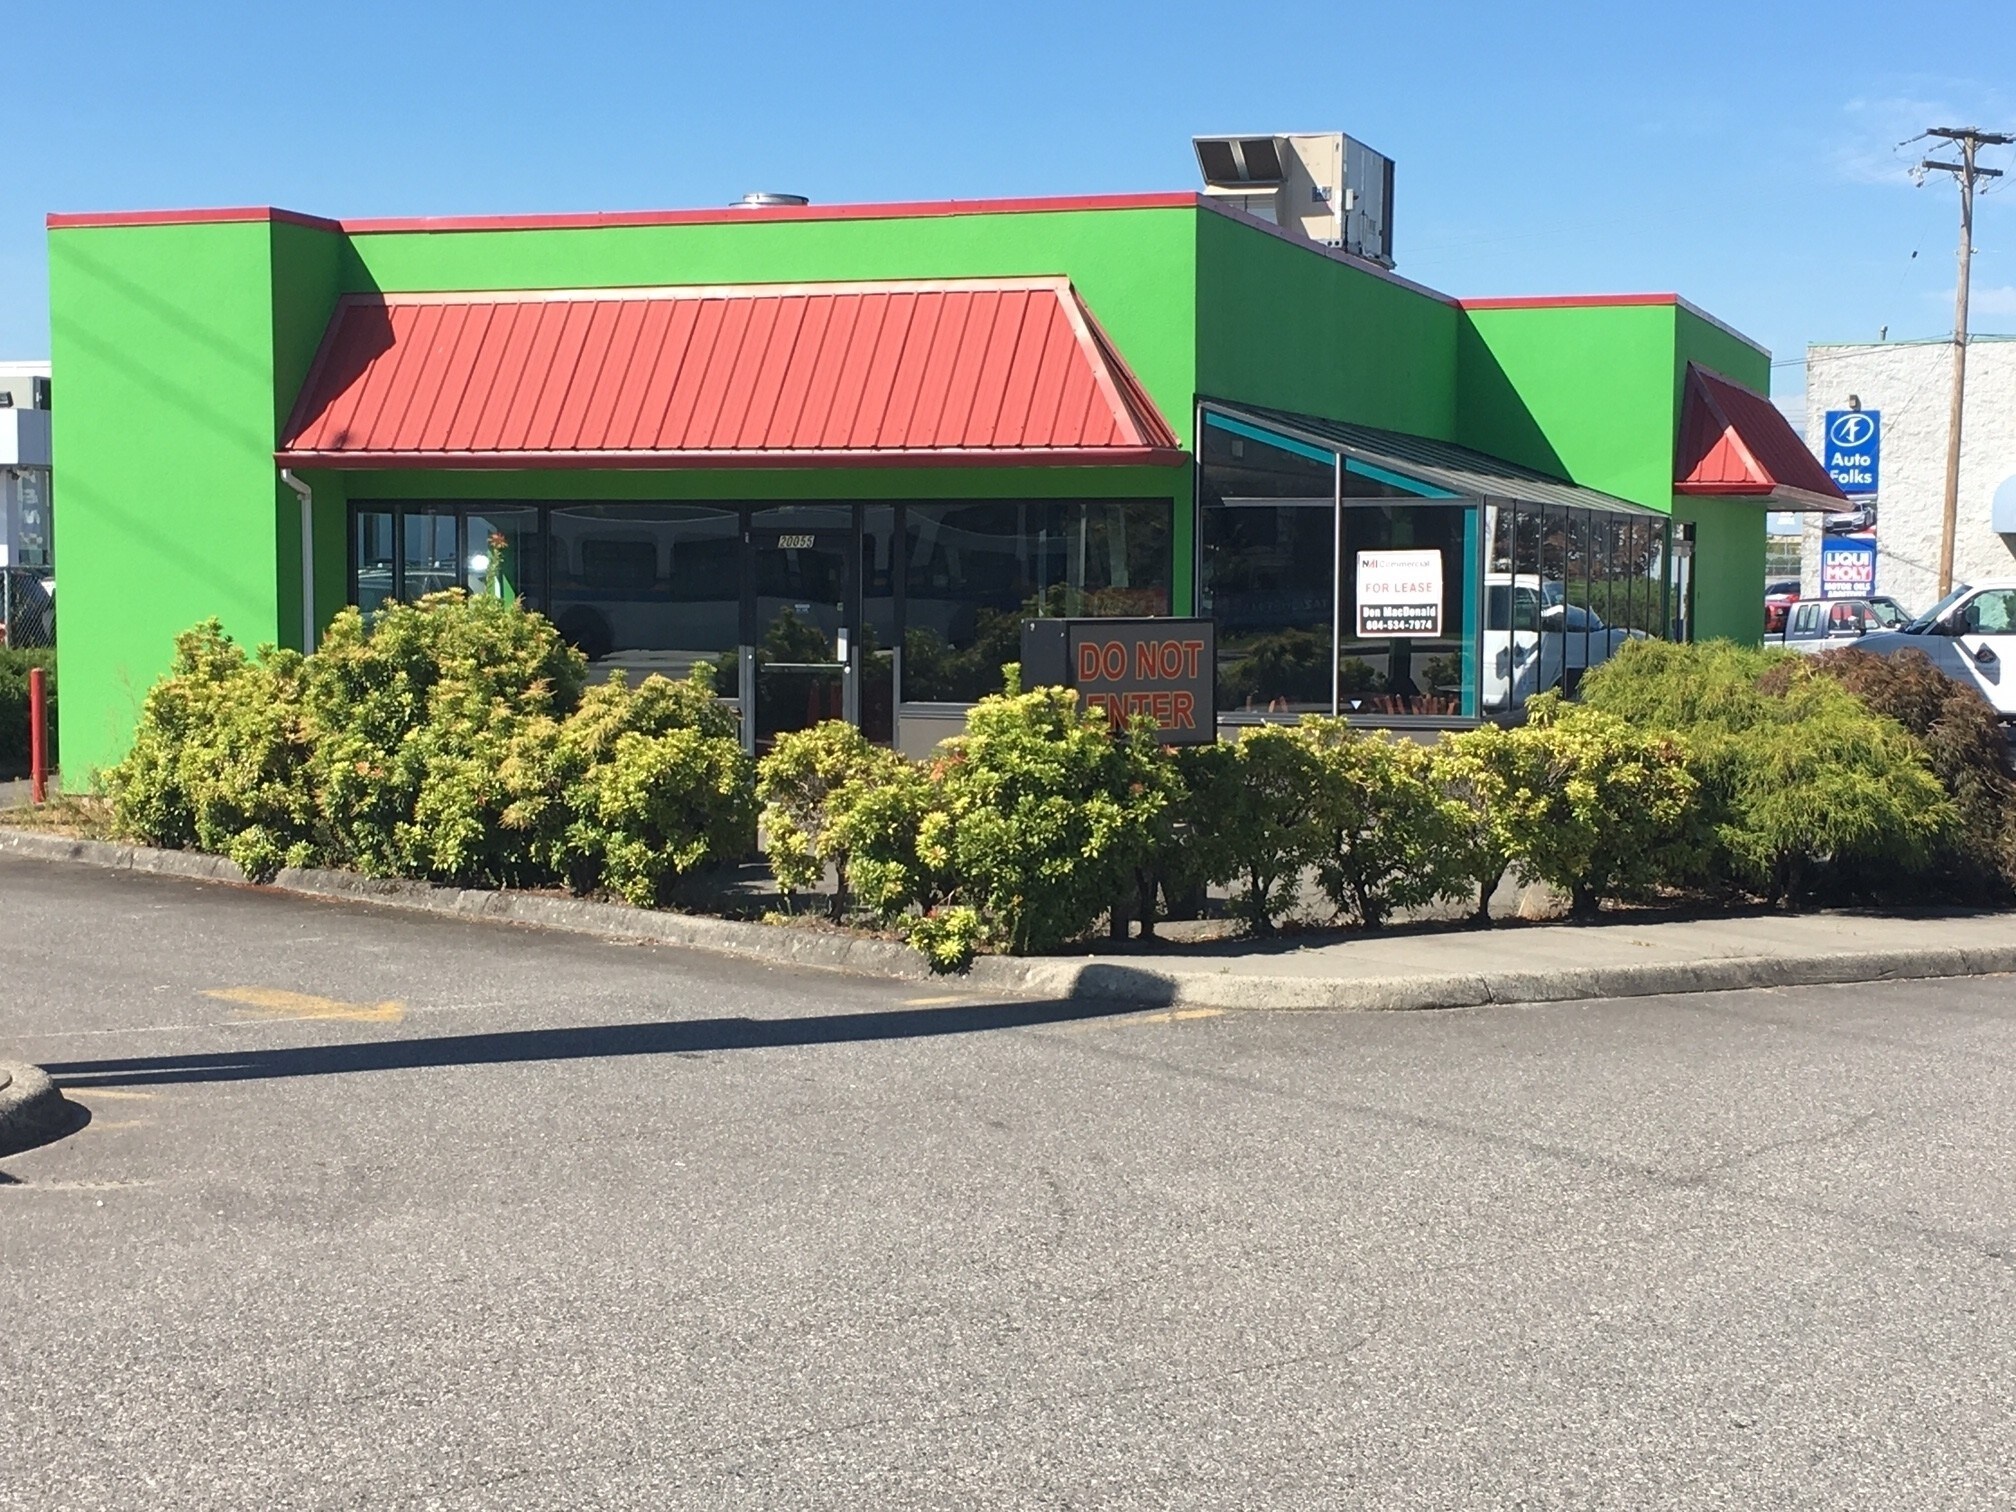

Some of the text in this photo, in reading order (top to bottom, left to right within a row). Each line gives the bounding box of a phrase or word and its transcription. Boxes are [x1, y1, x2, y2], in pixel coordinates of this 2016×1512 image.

[1831, 452, 1871, 466] Auto
[1830, 469, 1872, 484] Folks
[780, 535, 813, 547] 20055
[1826, 552, 1869, 566] LIQUI
[1826, 566, 1871, 580] MOLY
[1365, 582, 1432, 593] FOR LEASE
[1363, 606, 1436, 617] Don MacDonald
[1078, 640, 1204, 682] DO NOT
